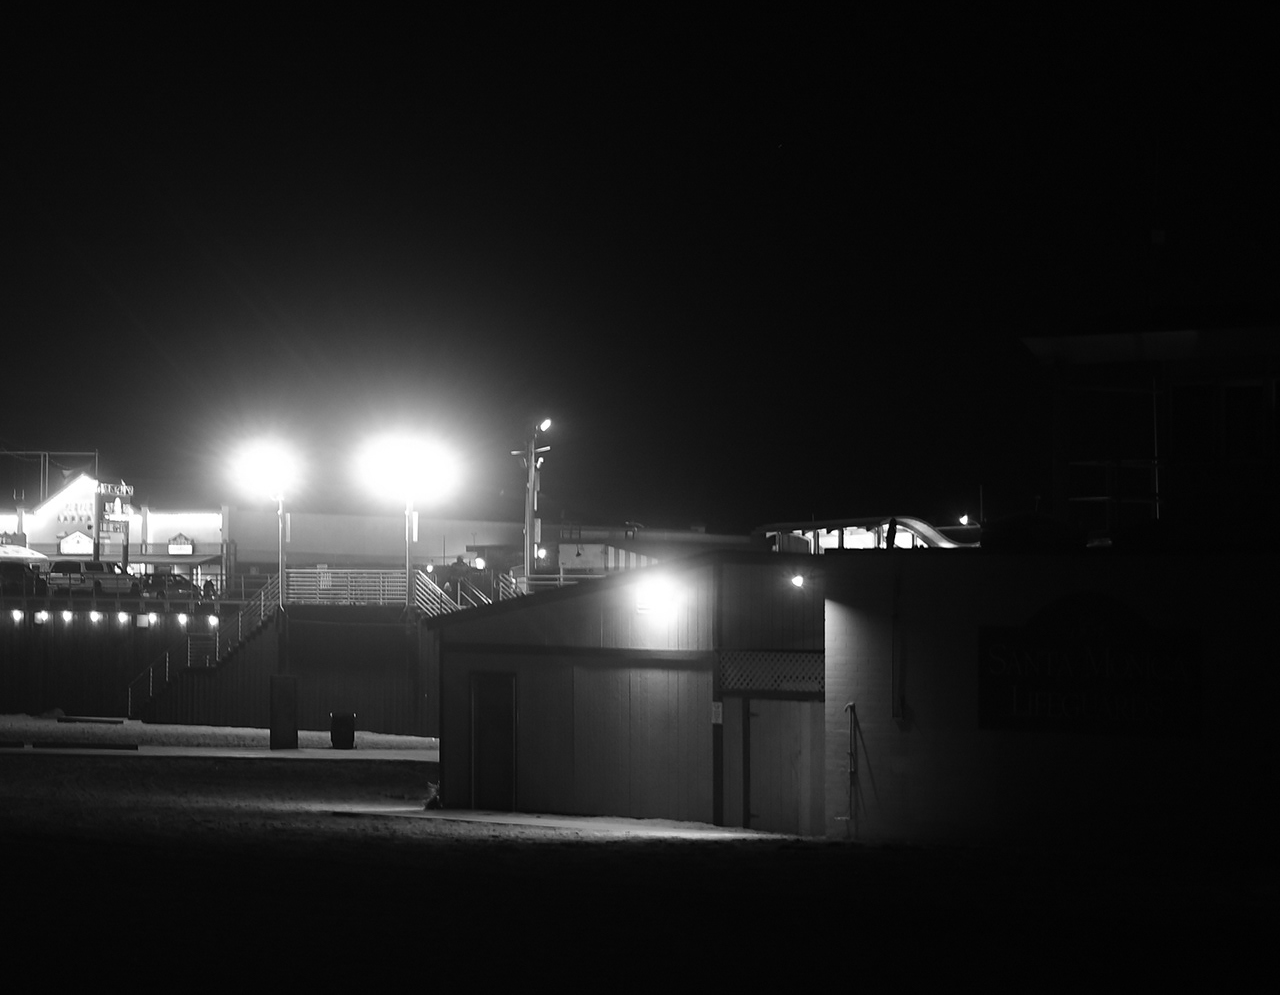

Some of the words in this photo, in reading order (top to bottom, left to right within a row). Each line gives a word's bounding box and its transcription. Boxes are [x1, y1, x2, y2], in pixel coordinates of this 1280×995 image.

[988, 643, 1074, 681] SANTA
[1081, 645, 1188, 683] MONICA
[1010, 684, 1164, 723] LIFEGUARDS
